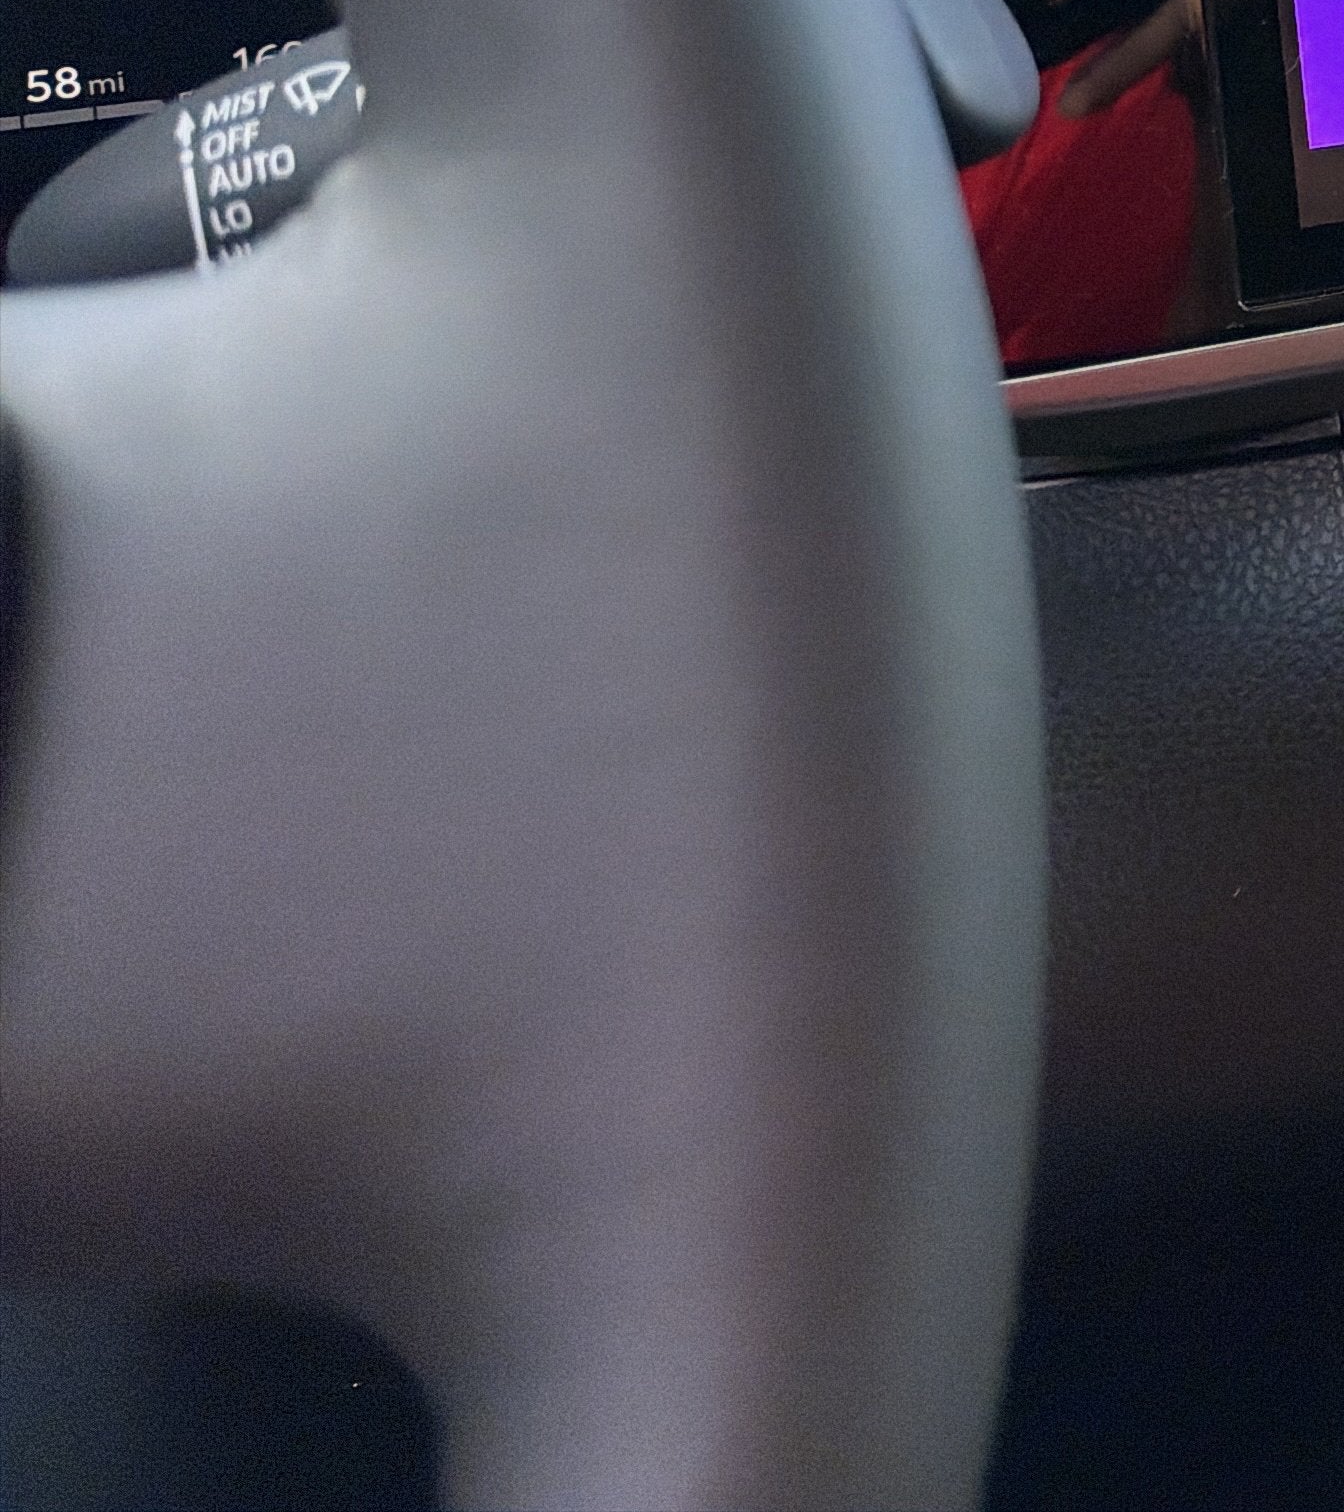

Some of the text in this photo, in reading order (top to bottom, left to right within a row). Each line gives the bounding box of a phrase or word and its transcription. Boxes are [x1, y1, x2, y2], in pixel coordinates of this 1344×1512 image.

[26, 66, 125, 103] 58 mi
[202, 81, 275, 130] MIST
[201, 120, 260, 162] OFF
[208, 143, 296, 199] AUTO
[210, 199, 253, 237] LO
